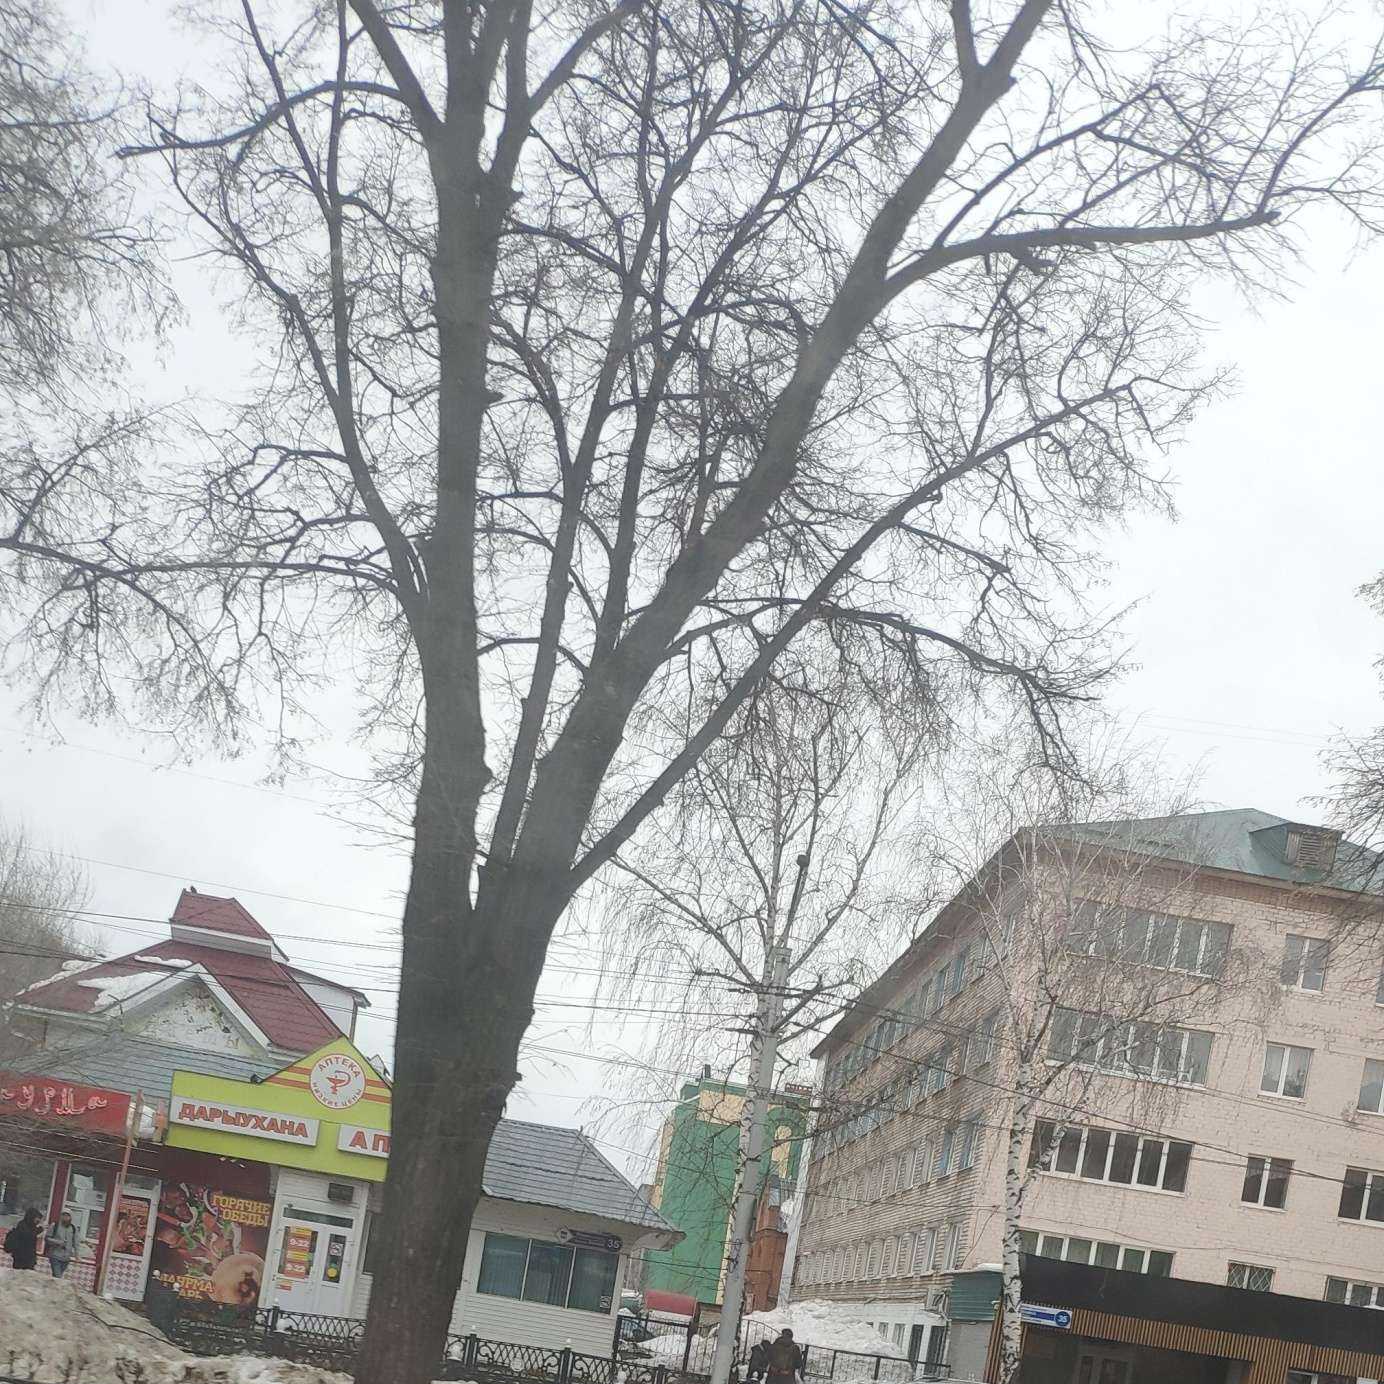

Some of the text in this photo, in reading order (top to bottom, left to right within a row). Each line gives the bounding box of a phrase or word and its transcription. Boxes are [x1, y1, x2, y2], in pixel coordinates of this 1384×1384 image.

[318, 1056, 361, 1078] АПТЕКА
[178, 1102, 309, 1139] ДАРЫУХАНА
[212, 1194, 271, 1215] ГОРЯЧИЕ
[221, 1208, 270, 1227] ОБЕДЫ
[607, 1239, 621, 1249] 35
